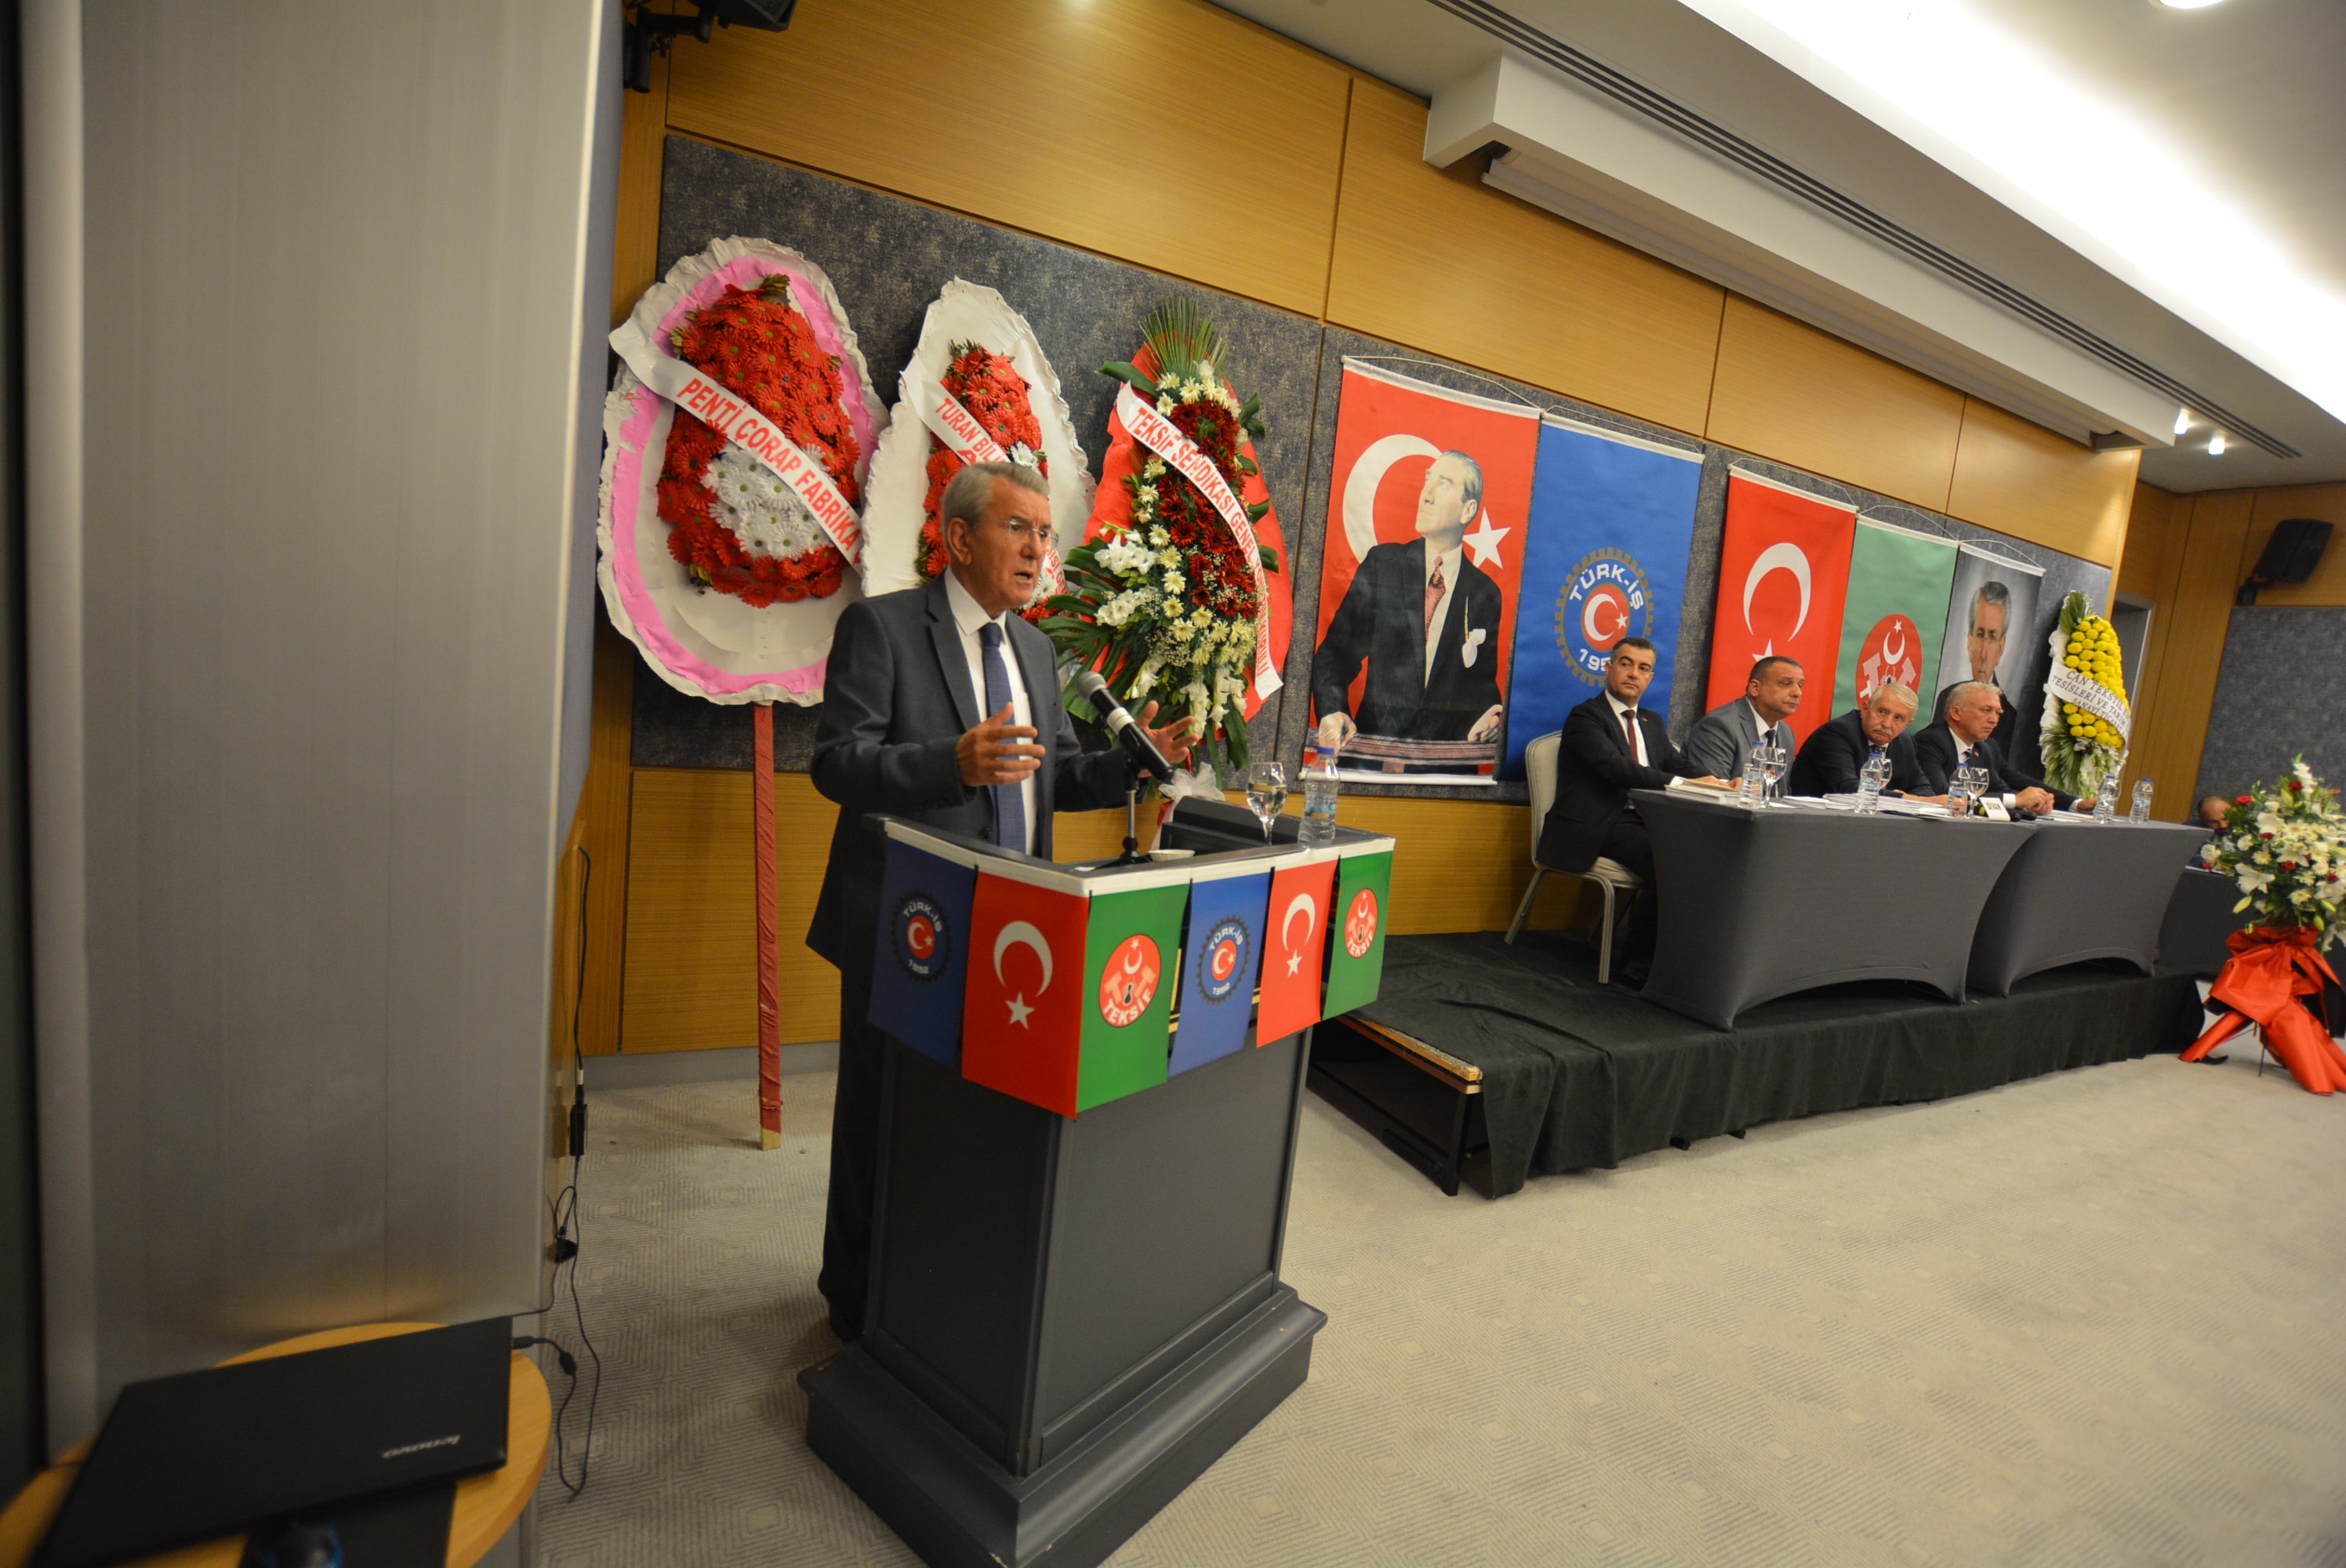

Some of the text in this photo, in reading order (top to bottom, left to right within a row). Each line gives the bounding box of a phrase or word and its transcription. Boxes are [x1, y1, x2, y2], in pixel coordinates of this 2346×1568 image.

[935, 397, 982, 443] TURAN
[677, 378, 862, 551] PENTİ ÇORAP FABRİKA
[1128, 407, 1182, 452] TEKSİF
[1230, 511, 1255, 562] GENEL
[1569, 563, 1644, 611] TÜRK-İŞ
[1579, 648, 1611, 672] 195
[2066, 670, 2089, 686] CAN
[2052, 675, 2097, 702] TESİSLERİ
[2097, 697, 2108, 709] VE
[2072, 698, 2101, 715] SANAYİ
